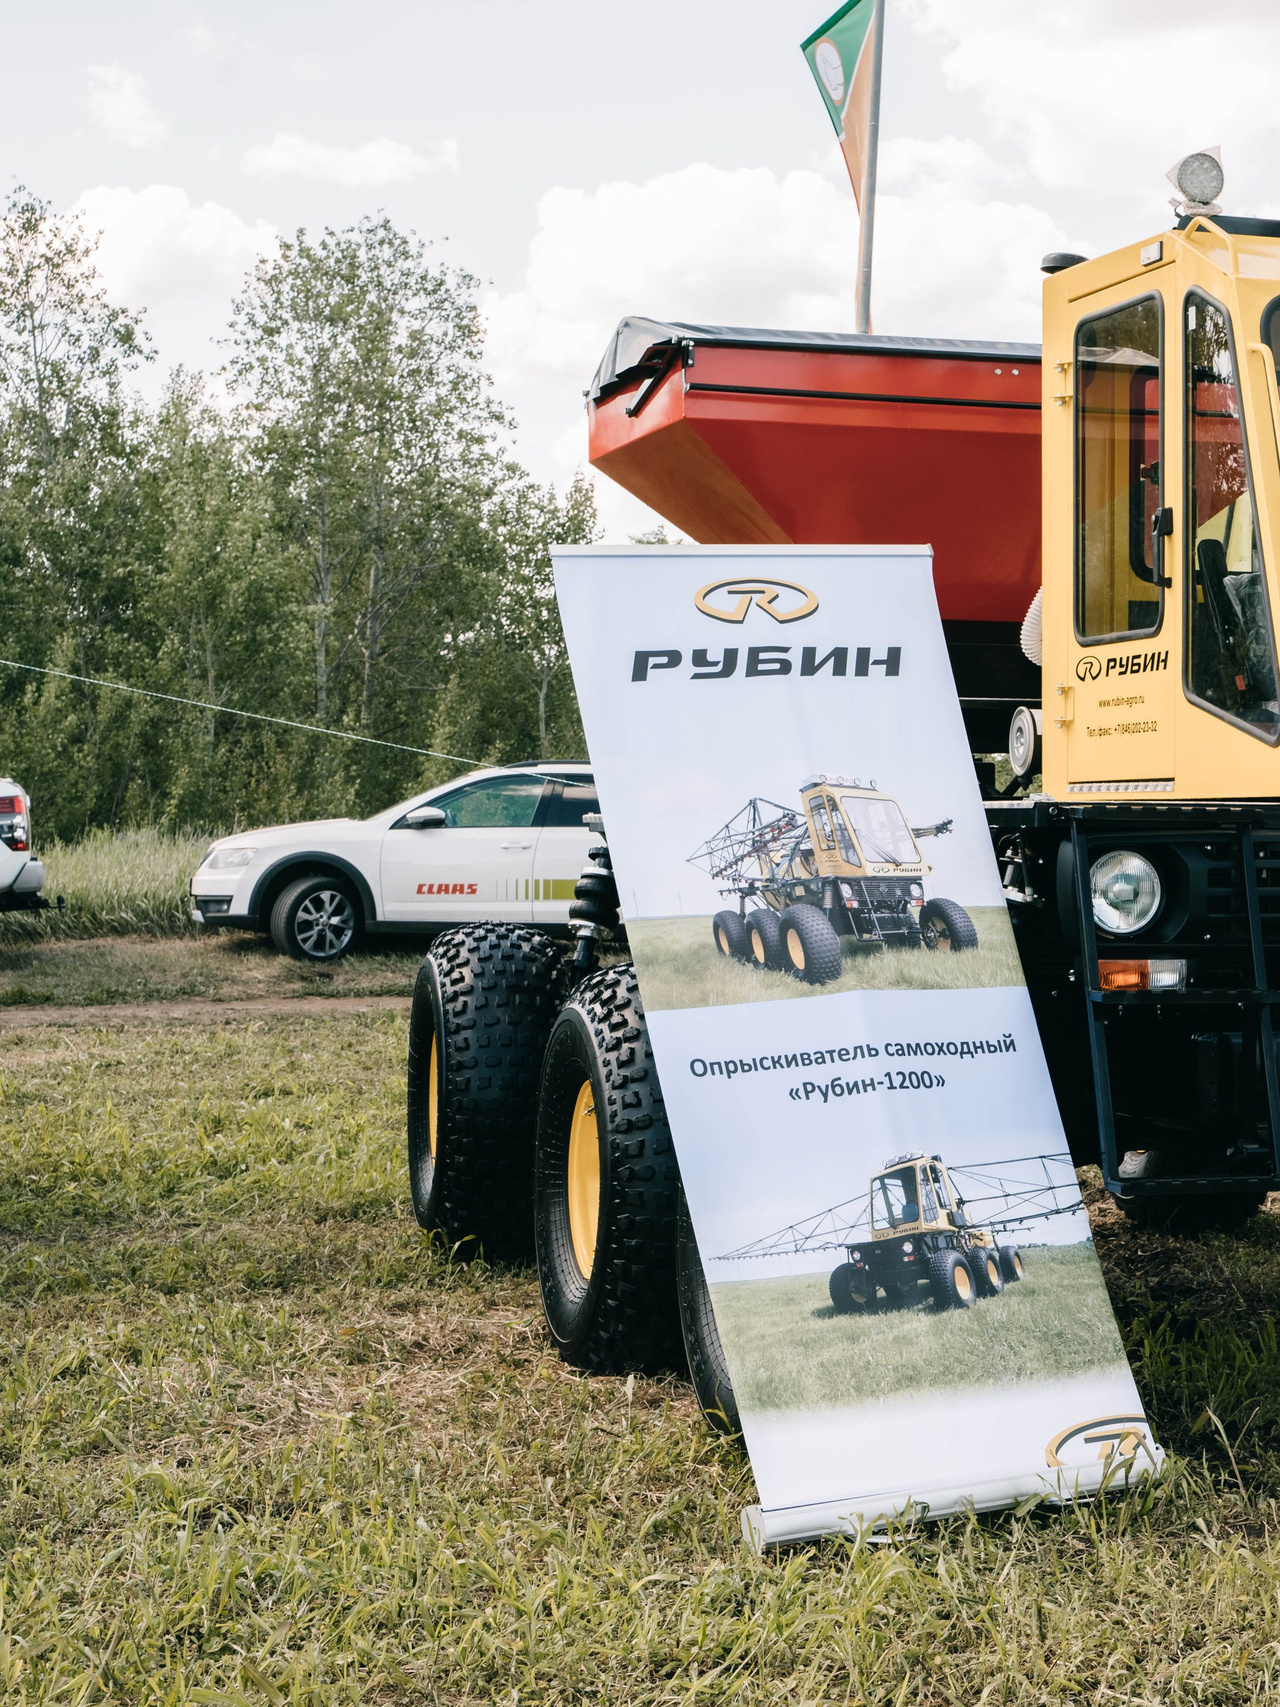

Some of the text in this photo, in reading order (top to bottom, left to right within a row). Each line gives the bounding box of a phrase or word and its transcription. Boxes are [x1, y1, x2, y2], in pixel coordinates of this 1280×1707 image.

[631, 645, 902, 682] РУБИН
[1105, 650, 1169, 677] РУБИН
[1098, 695, 1145, 708] www.rubin-agro.ru
[416, 883, 478, 895] CLAAS
[689, 1033, 1017, 1079] Опрыскиватель самоходный
[788, 1070, 946, 1103] «Рубин-1200»
